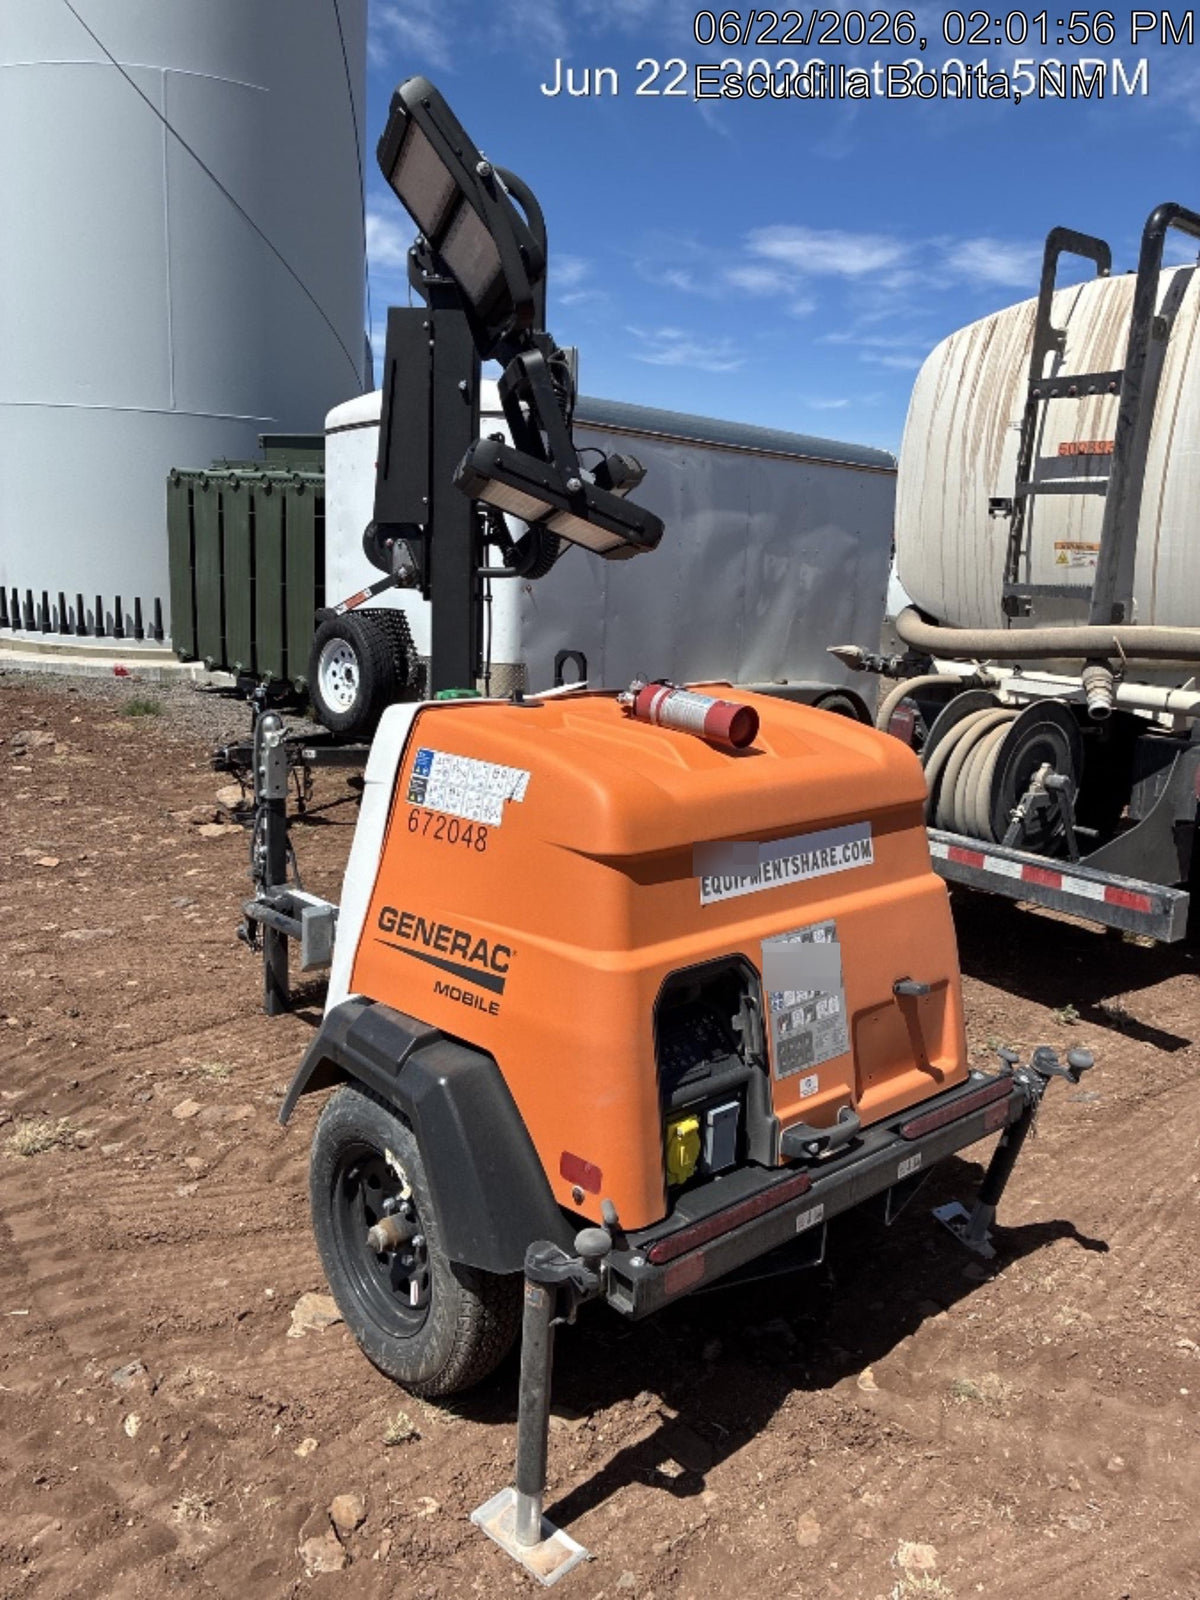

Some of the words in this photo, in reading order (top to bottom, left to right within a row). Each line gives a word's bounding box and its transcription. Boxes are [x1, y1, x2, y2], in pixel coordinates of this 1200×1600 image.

[408, 808, 488, 853] 672048
[378, 905, 511, 973] GENERAC
[433, 980, 501, 1016] MOBILE
